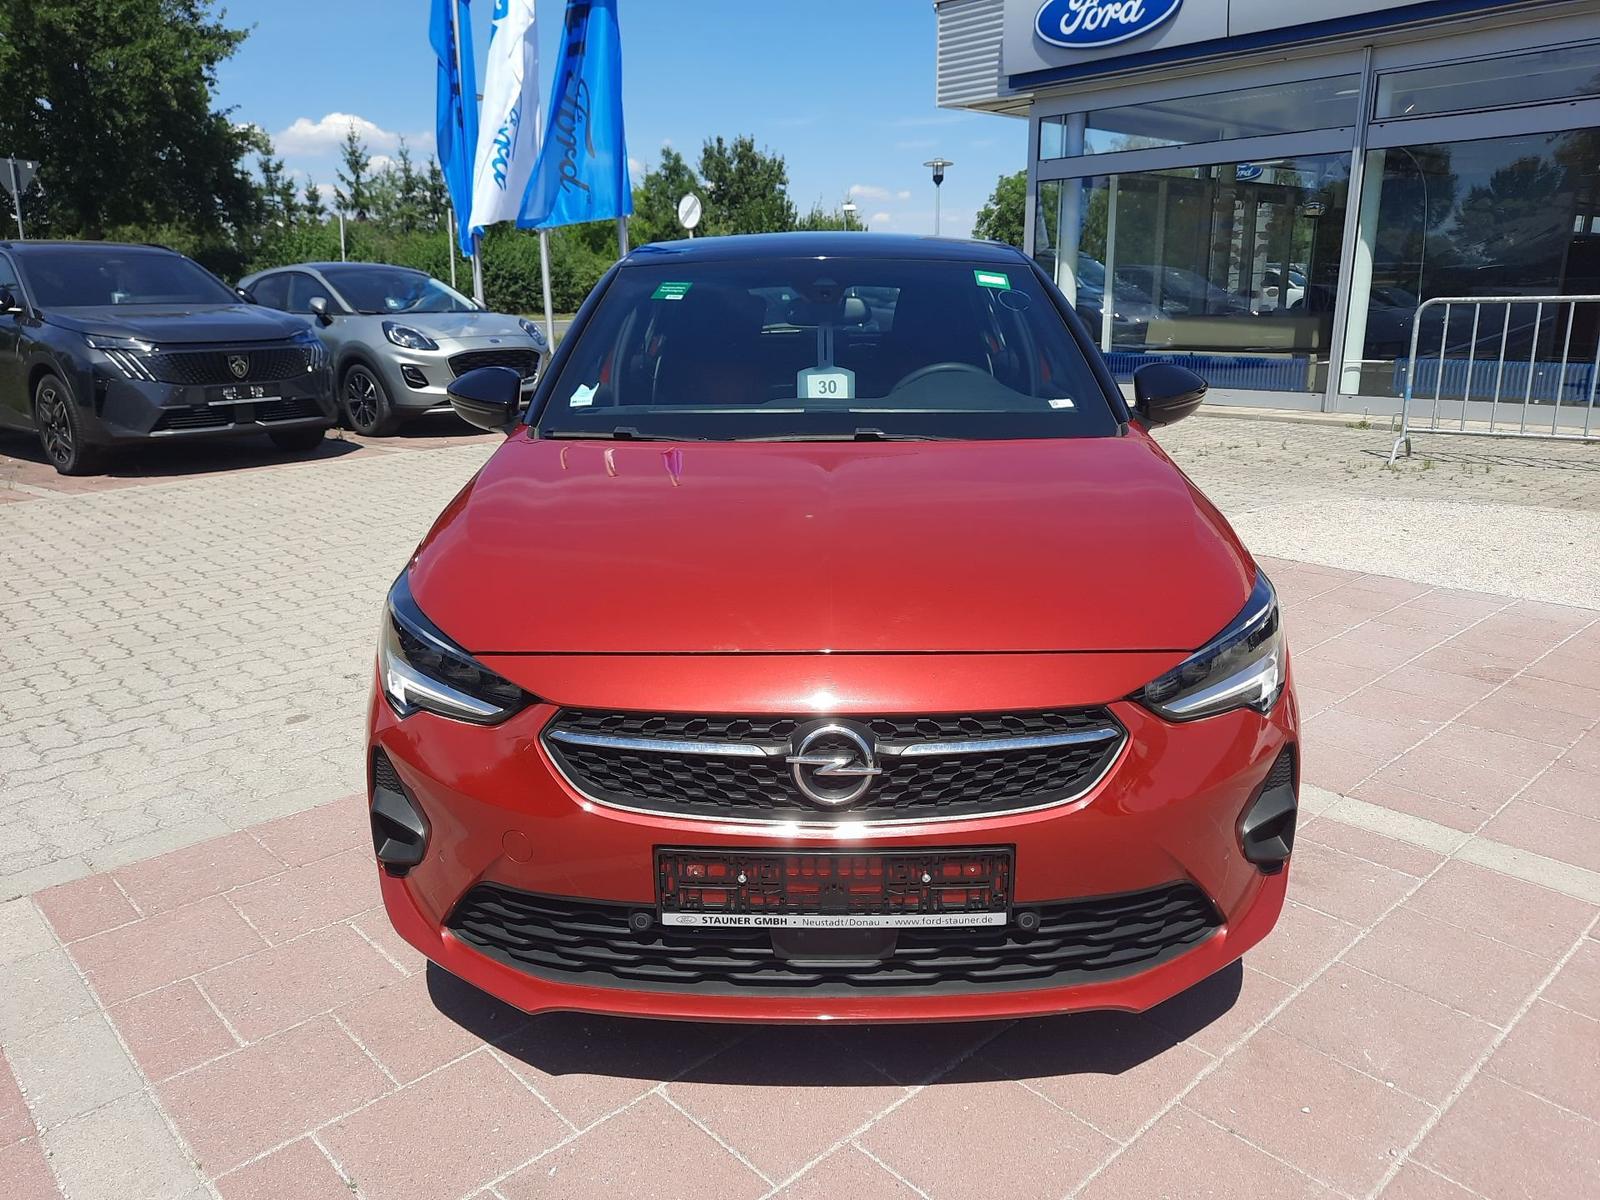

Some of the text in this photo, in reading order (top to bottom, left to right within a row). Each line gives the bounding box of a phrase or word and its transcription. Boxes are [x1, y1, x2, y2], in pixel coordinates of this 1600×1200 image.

[1060, 0, 1145, 35] Ford
[556, 78, 596, 194] Ford
[817, 379, 838, 395] 30
[702, 916, 751, 925] STAUNER
[754, 917, 788, 926] GMBH
[802, 917, 881, 927] Neustadt/Donau
[894, 915, 994, 926] www.ford-stauner.de
